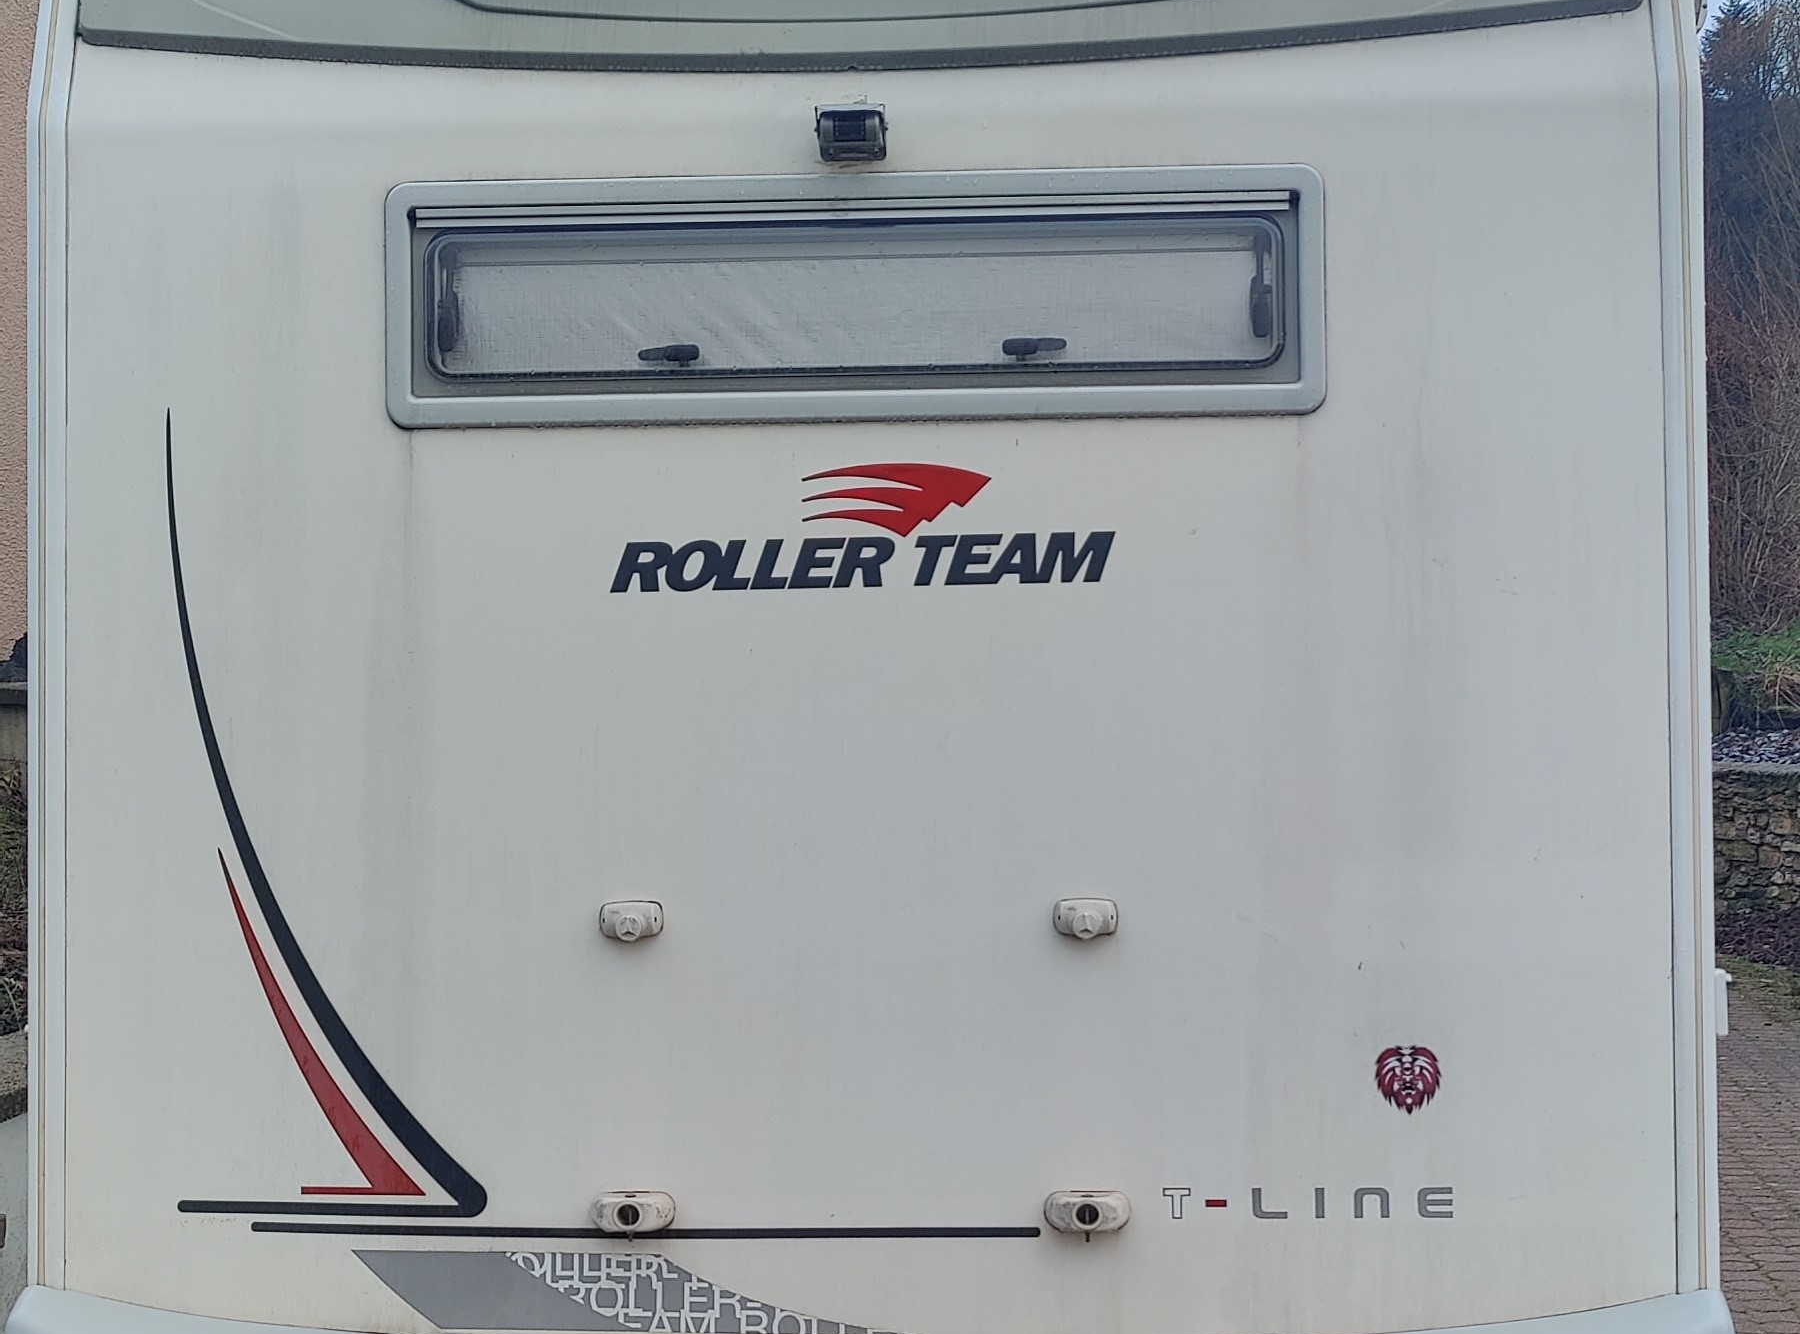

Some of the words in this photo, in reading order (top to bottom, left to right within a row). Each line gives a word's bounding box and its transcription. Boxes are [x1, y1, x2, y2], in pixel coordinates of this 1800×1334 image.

[609, 536, 896, 593] ROLLER
[913, 530, 1116, 587] TEAM
[1162, 1186, 1455, 1220] T-LINE
